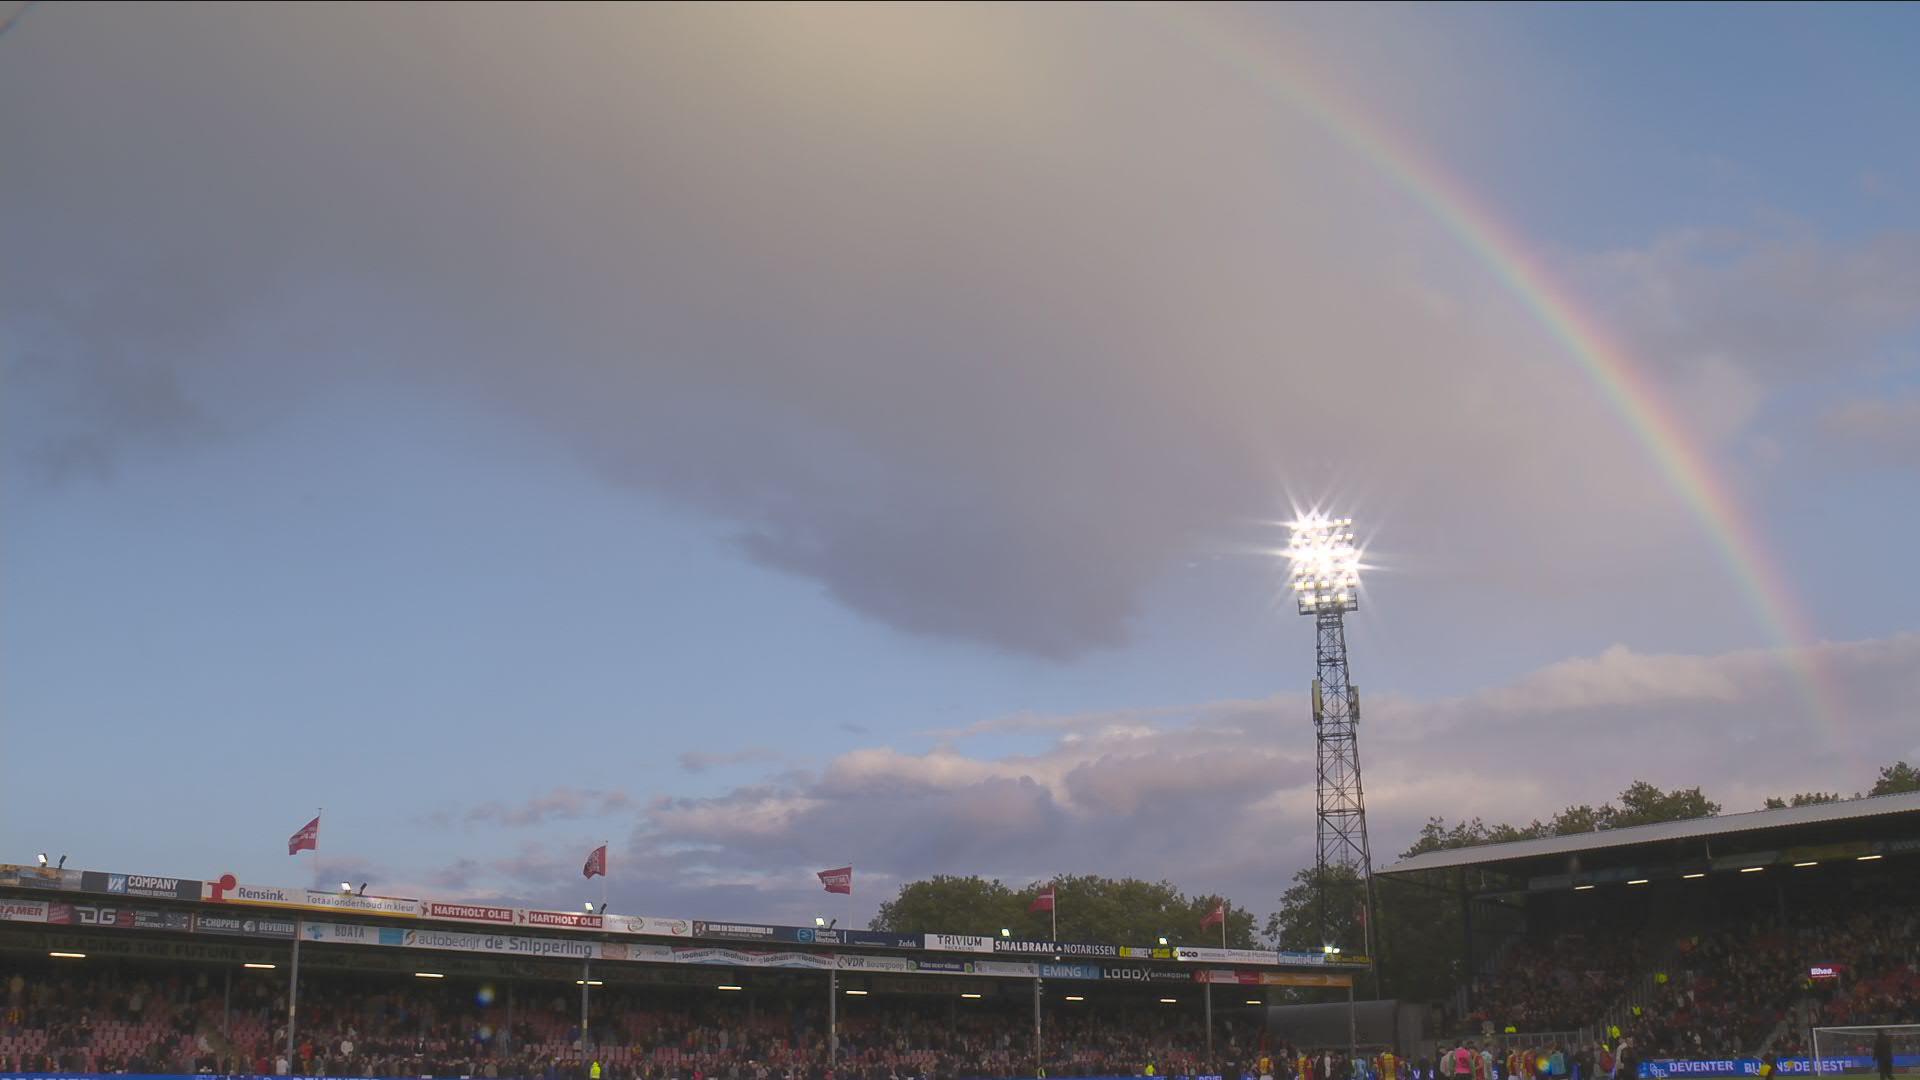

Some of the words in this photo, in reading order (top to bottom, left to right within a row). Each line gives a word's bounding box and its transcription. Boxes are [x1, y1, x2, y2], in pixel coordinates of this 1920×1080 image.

[128, 876, 178, 890] COMPANY
[307, 896, 382, 910] Totaalonderhoud
[394, 904, 415, 912] kleur
[434, 905, 485, 918] HARTHOLT
[488, 910, 511, 920] OLIE
[530, 912, 578, 925] HARTHOLT
[580, 917, 601, 926] OLIE
[419, 933, 481, 950] autobedrijf
[484, 936, 503, 949] de
[510, 937, 593, 957] Snipperling
[937, 935, 982, 947] TRIVIUM
[995, 941, 1055, 953] SMALBRAAK
[1064, 944, 1116, 956] NOTARISSEN
[847, 957, 864, 968] VDR
[1669, 1060, 1734, 1073] DEVENTER
[1794, 1060, 1810, 1072] DE
